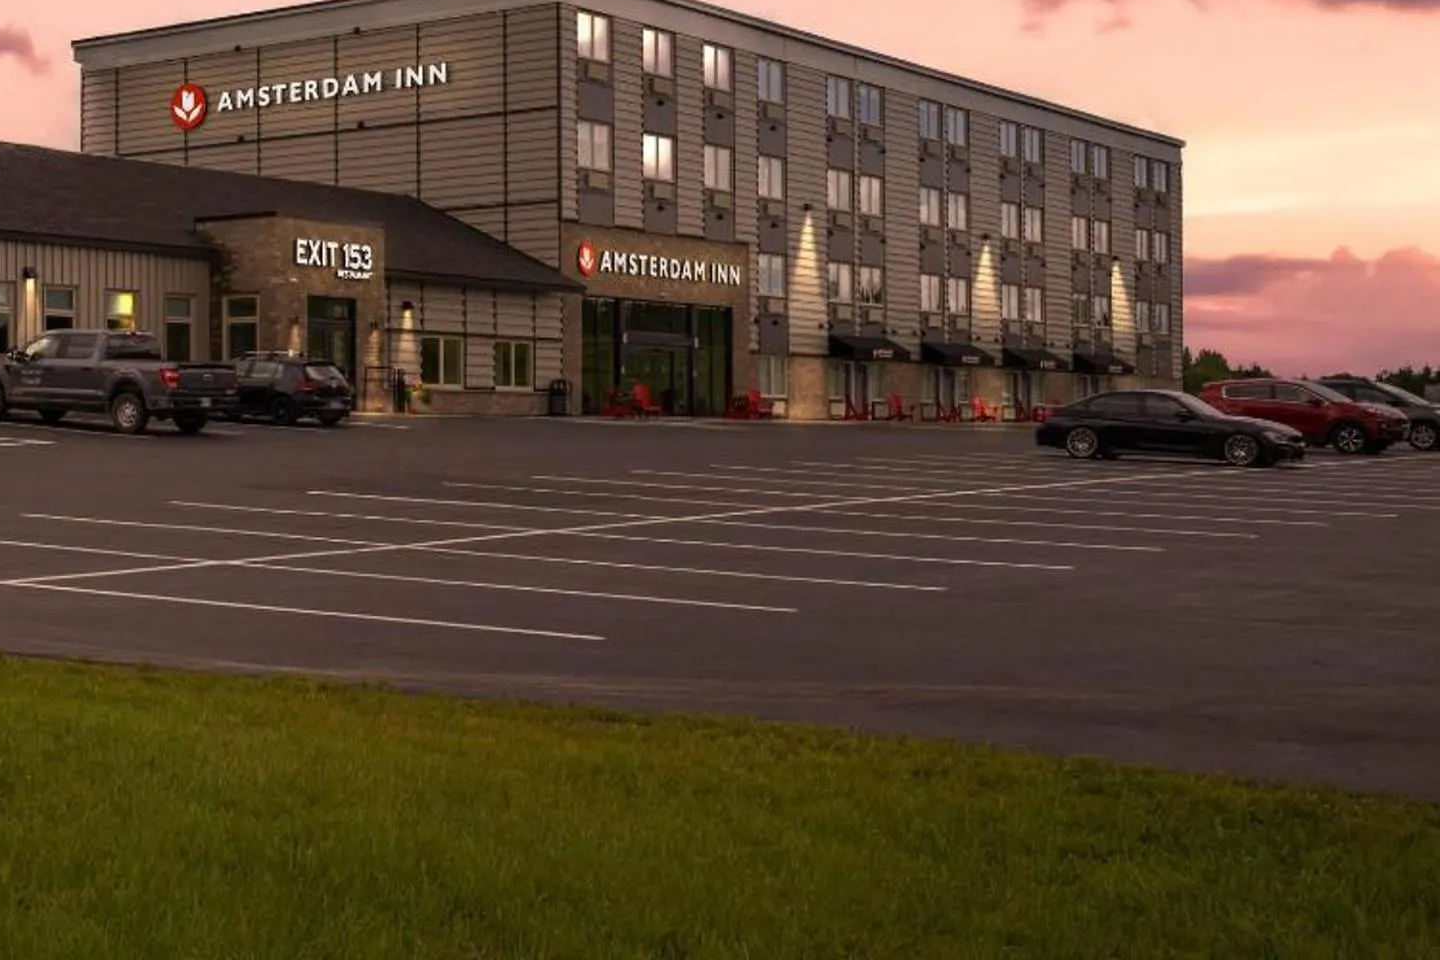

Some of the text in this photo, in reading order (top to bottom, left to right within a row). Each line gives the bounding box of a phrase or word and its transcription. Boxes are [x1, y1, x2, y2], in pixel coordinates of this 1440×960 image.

[216, 62, 448, 113] AMSTERDAM INN
[296, 238, 373, 270] EXIT 153
[599, 250, 741, 286] AMSTERDAM INN
